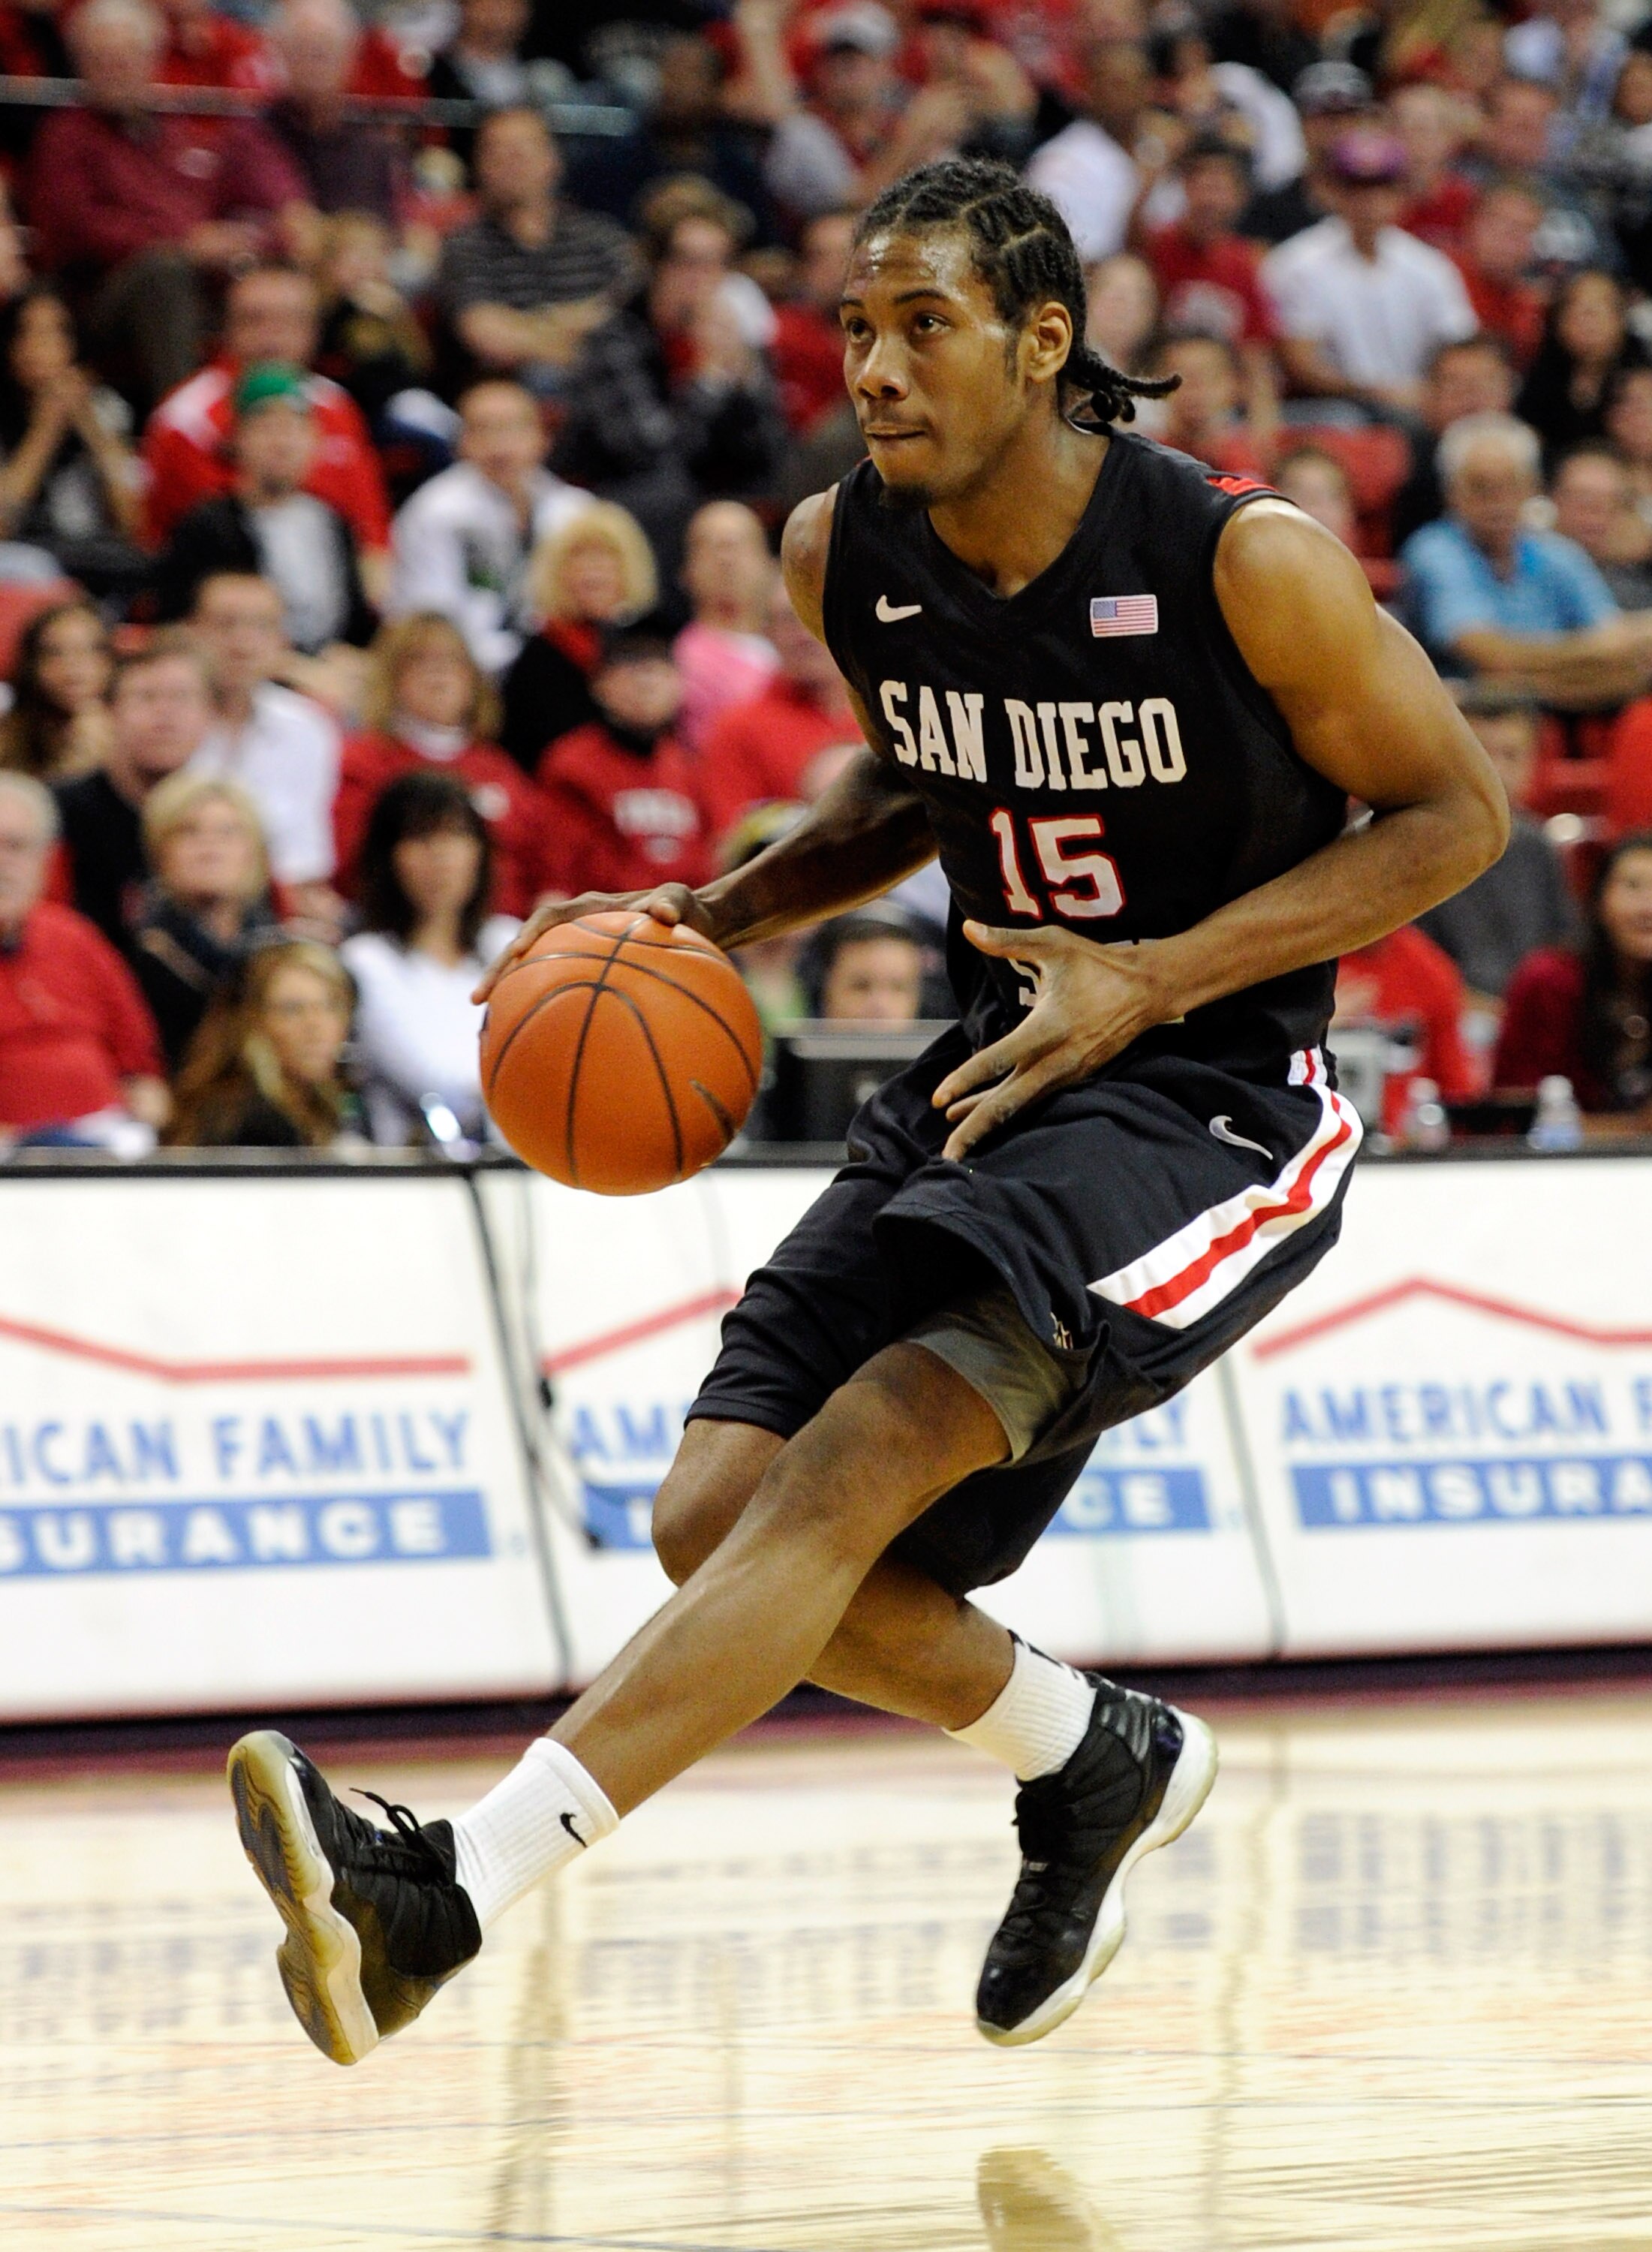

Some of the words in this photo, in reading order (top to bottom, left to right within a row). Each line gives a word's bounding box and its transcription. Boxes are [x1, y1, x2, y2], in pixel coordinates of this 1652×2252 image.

[880, 680, 988, 783] SAN
[1004, 697, 1187, 790] DIEGO
[988, 807, 1125, 920] 15
[210, 1409, 470, 1480] FAMILY
[570, 1403, 691, 1462] AM
[1283, 1380, 1608, 1446] AMERICAN
[1330, 1461, 1652, 1524] INSURA
